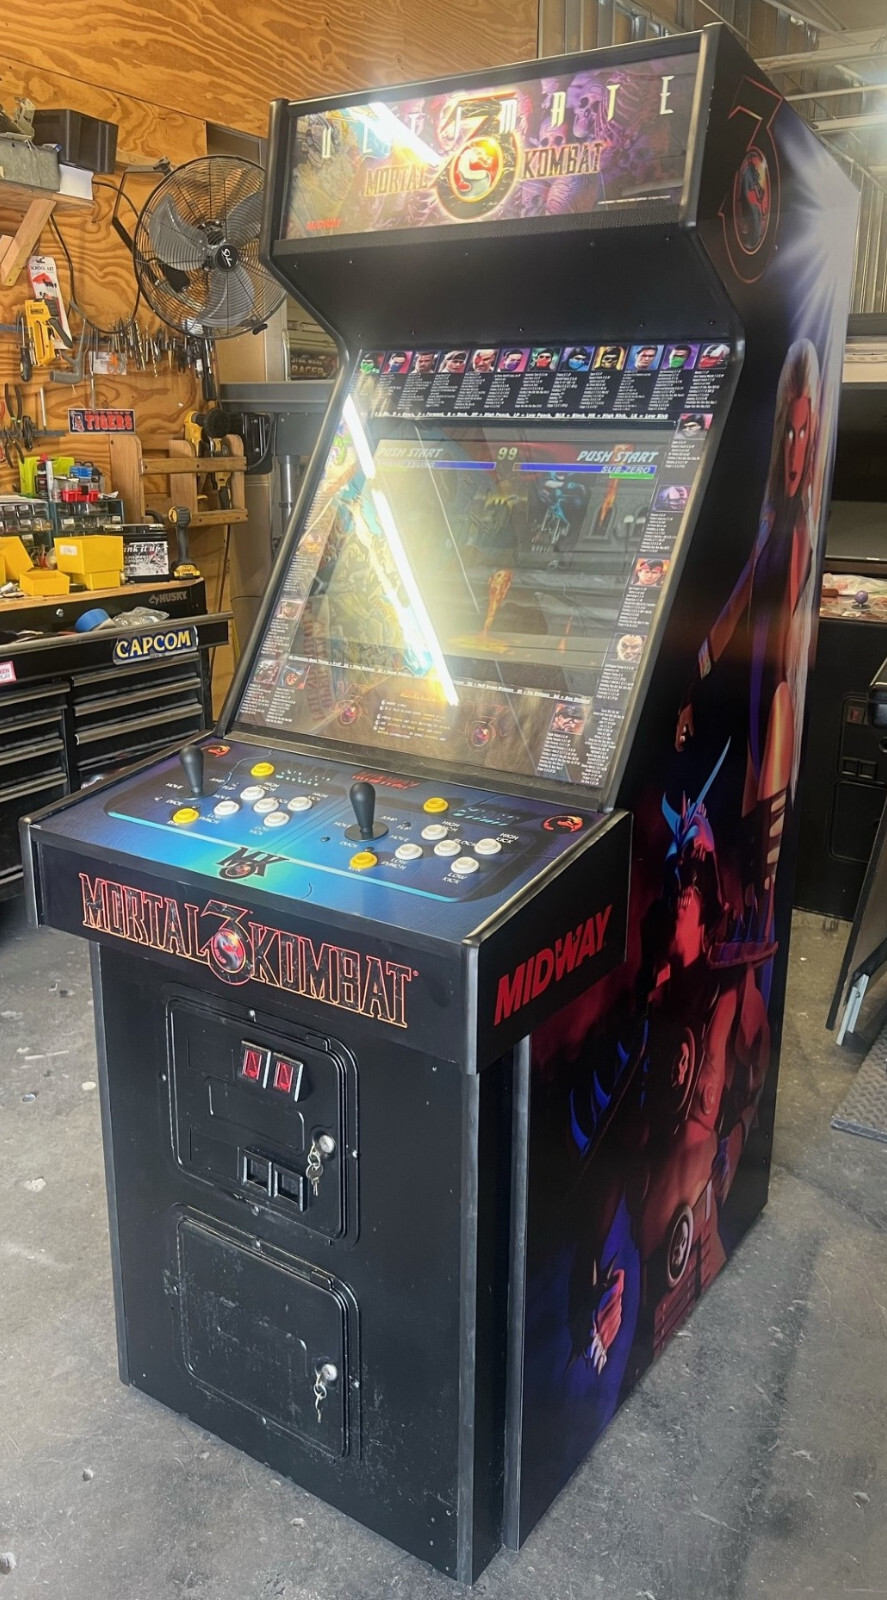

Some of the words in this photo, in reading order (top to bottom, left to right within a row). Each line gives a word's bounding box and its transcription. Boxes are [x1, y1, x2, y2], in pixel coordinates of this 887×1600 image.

[521, 142, 603, 180] KOMBAT
[85, 415, 133, 431] TIGERS
[408, 448, 443, 458] START
[498, 447, 518, 461] 99
[577, 450, 614, 463] PUSH
[614, 451, 659, 463] START
[600, 466, 652, 474] SUB-ZERO
[159, 590, 188, 604] HUSKY
[116, 630, 191, 658] CAPCOM
[499, 832, 520, 841] HIGH
[442, 876, 461, 885] KICK
[447, 872, 468, 880] LOW
[79, 873, 210, 966] MORTAL
[199, 899, 252, 986] 3
[248, 920, 412, 1029] KOMBAT
[494, 904, 612, 1026] MIDWAY
